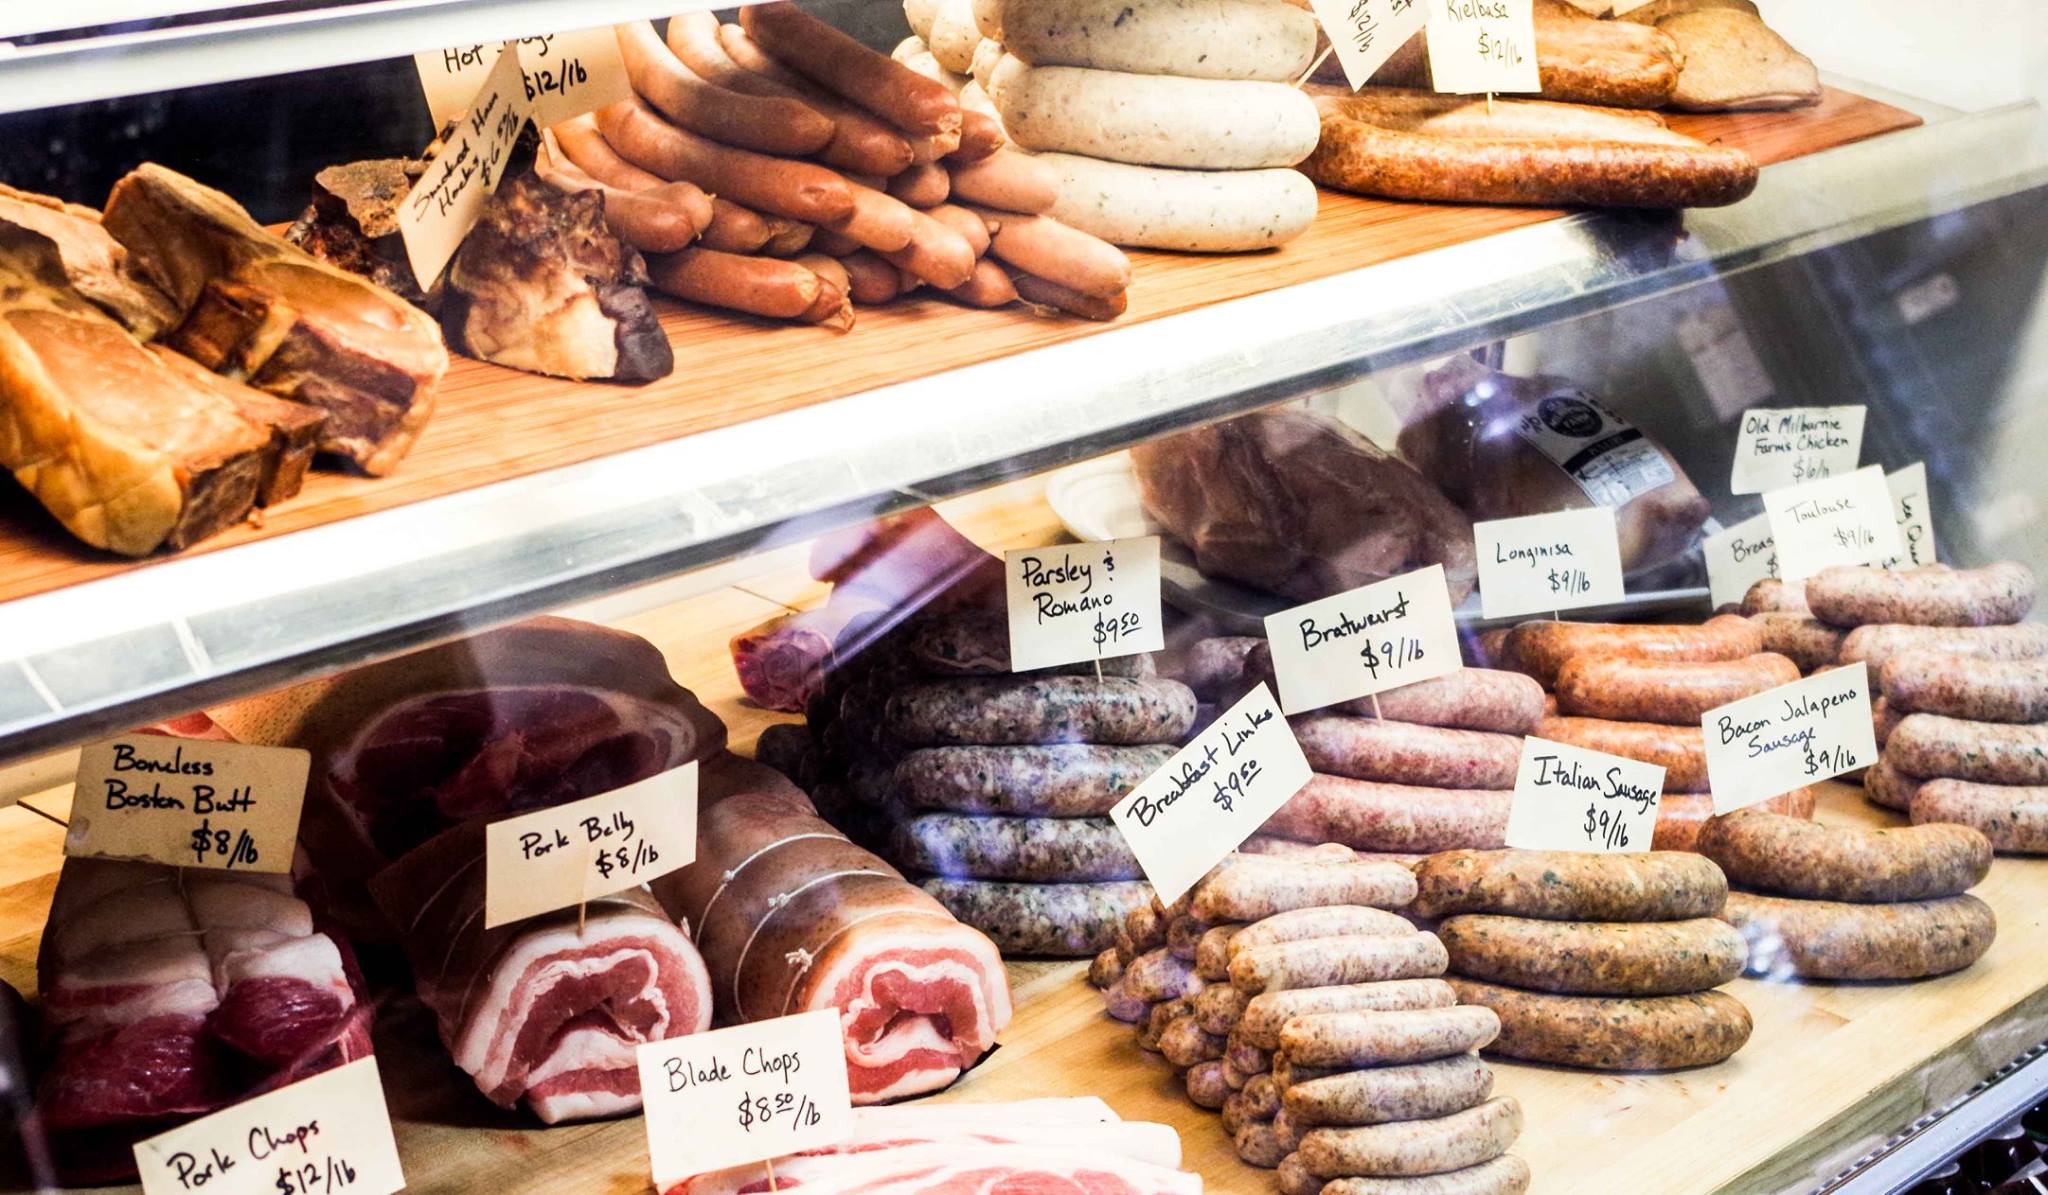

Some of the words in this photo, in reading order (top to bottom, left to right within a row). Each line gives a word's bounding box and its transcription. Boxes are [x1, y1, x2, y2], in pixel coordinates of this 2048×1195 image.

[443, 44, 484, 73] Hot
[1478, 26, 1522, 69] $12/lb
[520, 58, 588, 102] $12/lb
[413, 138, 470, 222] Smoked
[471, 92, 498, 136] Ham
[439, 155, 479, 217] Hocks
[1746, 416, 1770, 434] Old
[1797, 432, 1849, 450] Chicken
[1784, 499, 1857, 524] Toulouse
[1496, 542, 1573, 568] Longinisa
[1731, 537, 1775, 563] Breas
[1833, 523, 1874, 550] $9/lb
[1021, 553, 1092, 594] Parsley
[1547, 568, 1591, 597] $9/lb
[1032, 592, 1113, 625] Romano
[1300, 591, 1410, 651] Bratwurst
[1360, 638, 1425, 680] $9/lb
[1718, 715, 1770, 746] Bacon
[1780, 688, 1857, 723] Jalapeno
[113, 744, 214, 777] Boneless
[1747, 726, 1817, 759] Sausage
[1803, 745, 1857, 776] $9/lb
[1126, 744, 1218, 827] Breakfast
[1221, 709, 1273, 756] Links
[1533, 754, 1601, 792] Italian
[1604, 767, 1657, 815] Sausage
[104, 779, 185, 811] Boston
[193, 785, 256, 814] Butt
[191, 818, 258, 868] $8/lb
[519, 831, 570, 861] Pork
[579, 812, 635, 843] Belly
[1583, 803, 1629, 851] $9/lb
[595, 838, 660, 879] $8/lb
[663, 1056, 732, 1093] Blade
[742, 1047, 802, 1084] Chops
[166, 1148, 235, 1189] Pork
[247, 1118, 320, 1154] Chops
[275, 1155, 357, 1195] $12/lb
